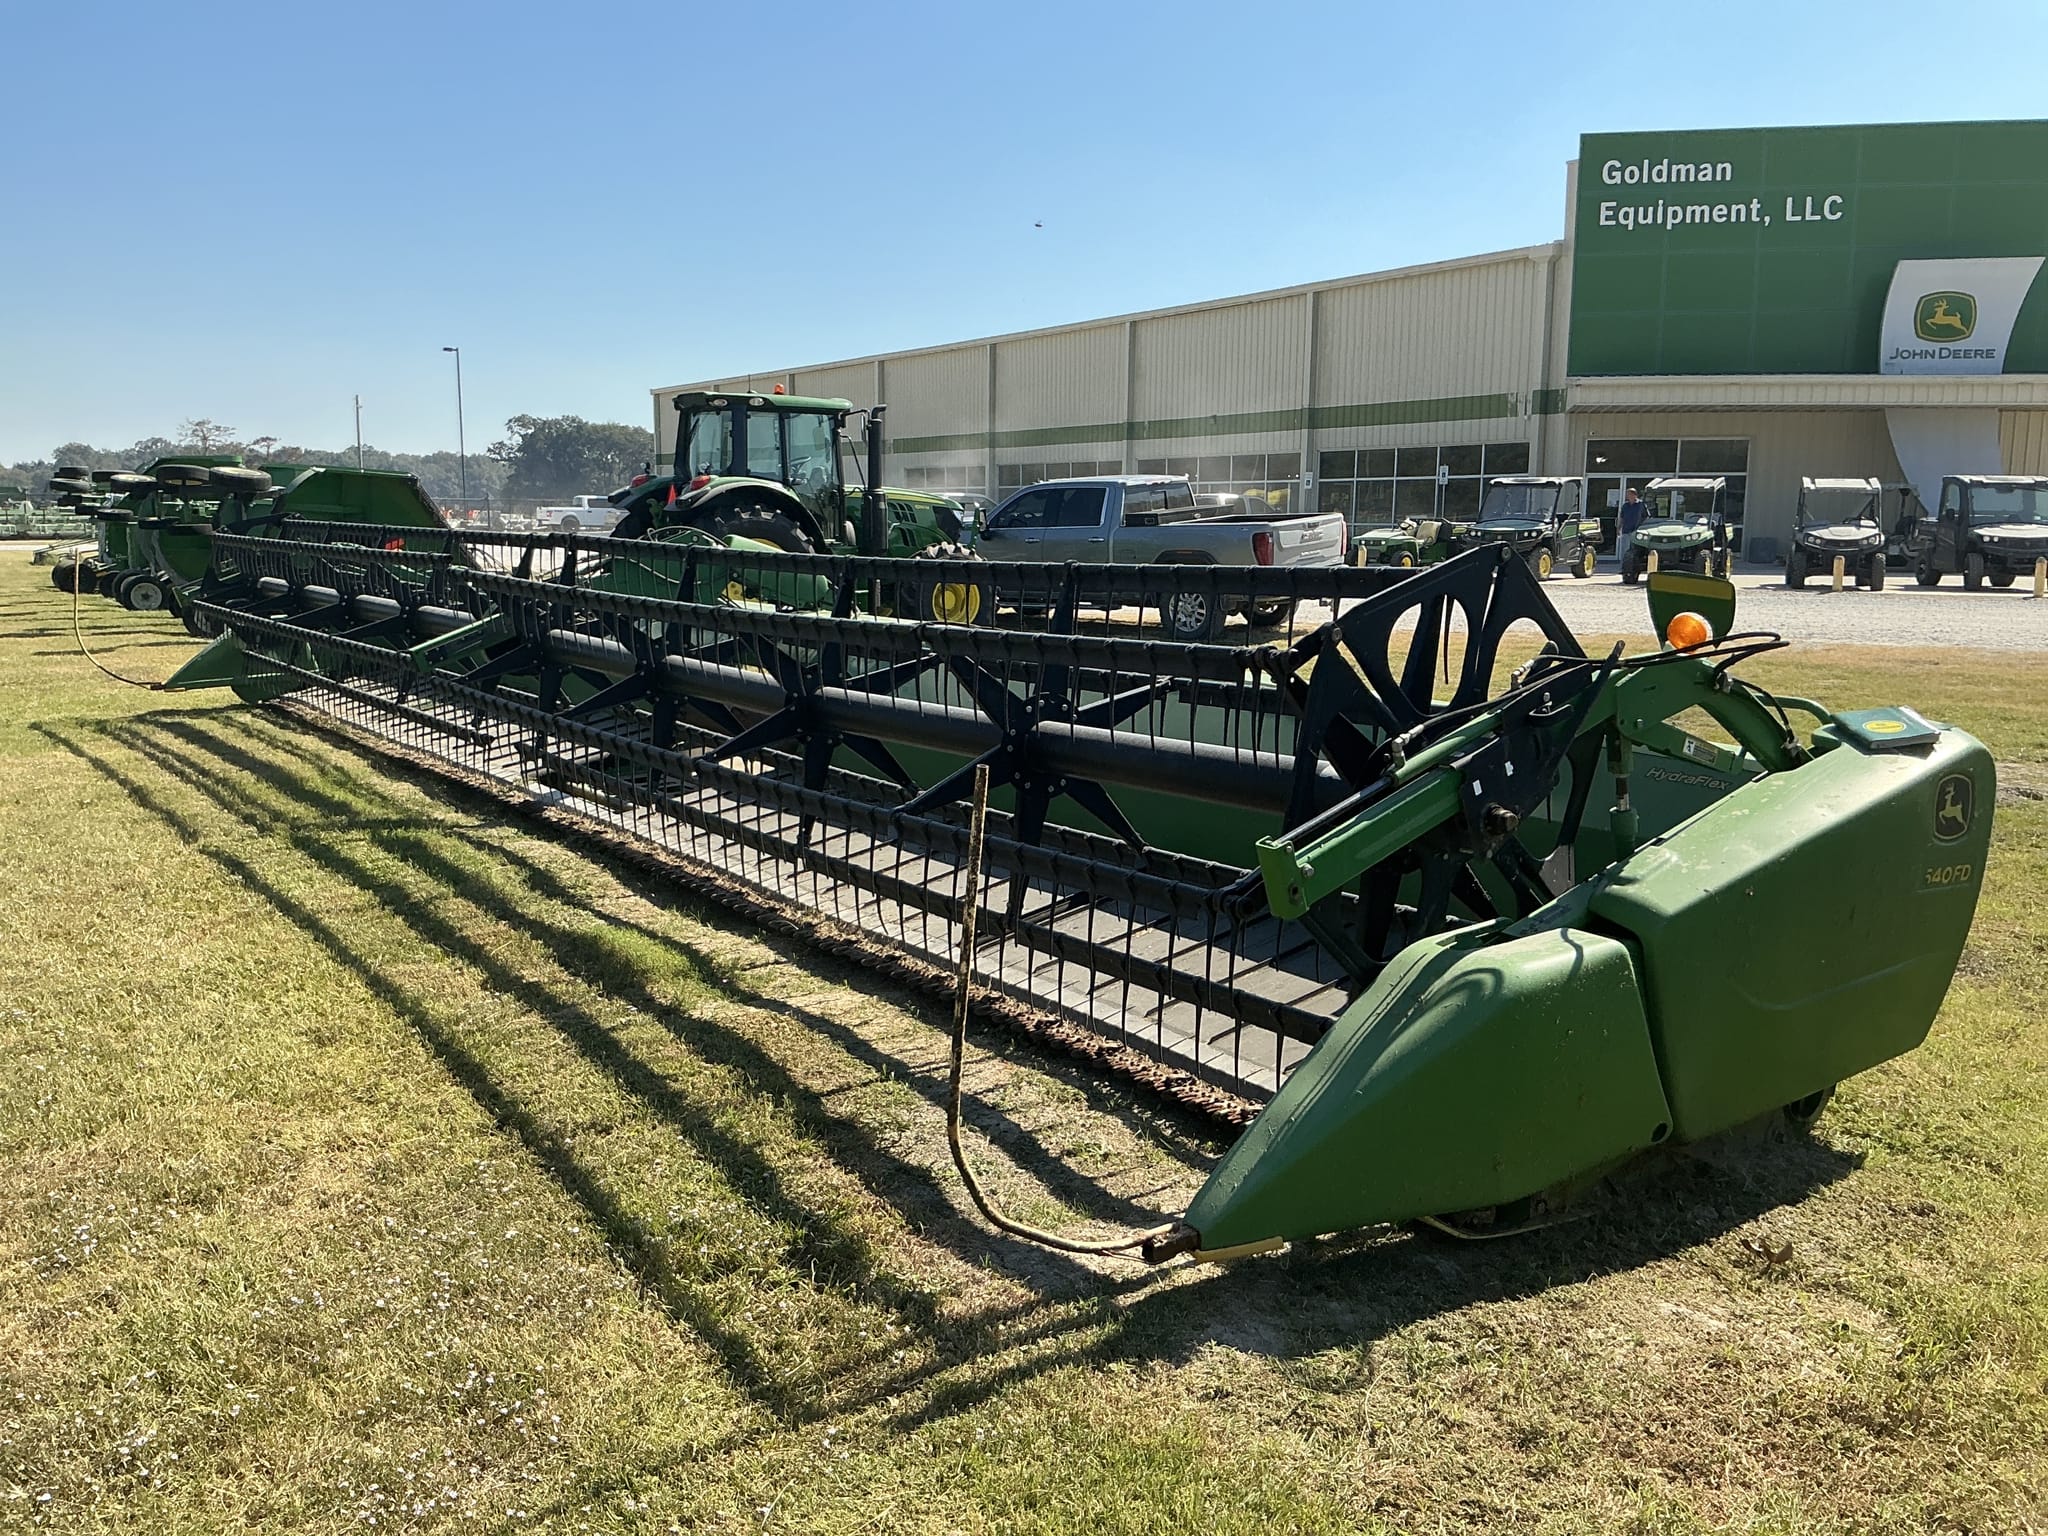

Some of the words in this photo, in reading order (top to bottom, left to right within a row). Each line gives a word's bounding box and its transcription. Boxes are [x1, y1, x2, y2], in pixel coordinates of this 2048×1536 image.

[1602, 159, 1732, 184] Goldman
[1599, 198, 1771, 230] Equipment,
[1785, 195, 1843, 221] LLC
[1889, 347, 1936, 360] JOHN
[1939, 347, 1996, 360] DEERE
[1646, 767, 1729, 790] HydraFlex
